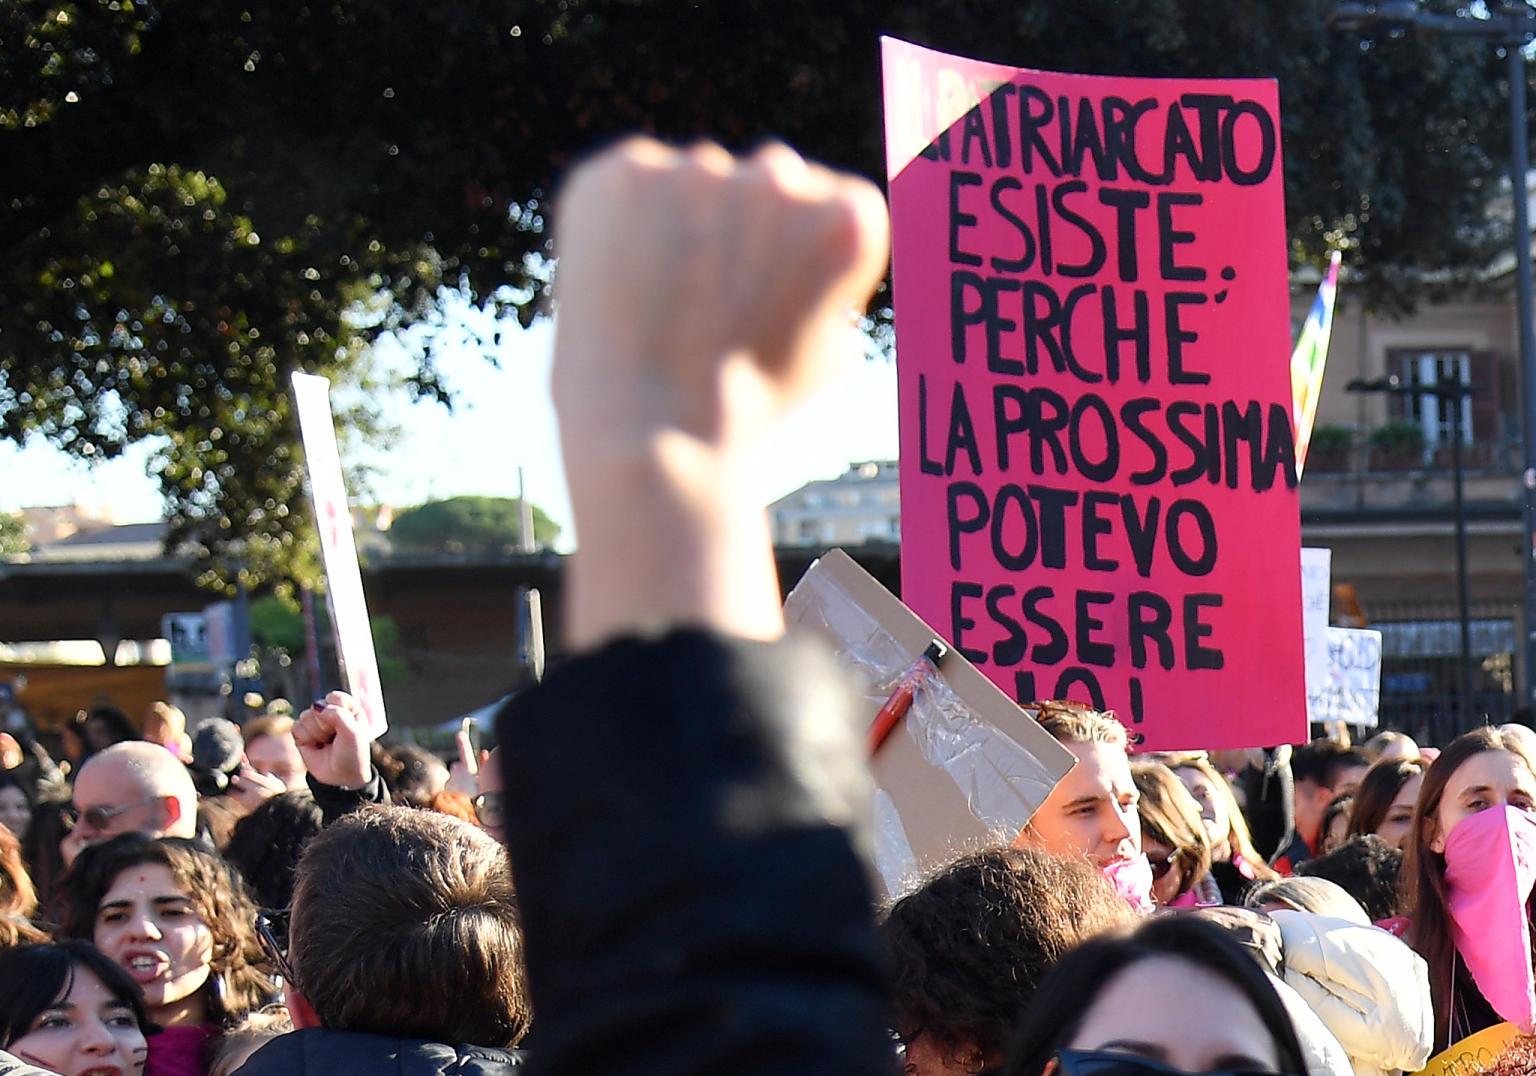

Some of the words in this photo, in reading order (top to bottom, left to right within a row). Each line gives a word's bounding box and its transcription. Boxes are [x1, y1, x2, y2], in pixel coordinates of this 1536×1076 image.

[937, 68, 1276, 186] PATRIARCATO
[949, 170, 1236, 283] ESISTE.
[918, 373, 984, 478] LA
[991, 383, 1298, 493] PROSSIMA
[946, 481, 1219, 578] POTEVO
[950, 580, 1226, 671] ESSERE
